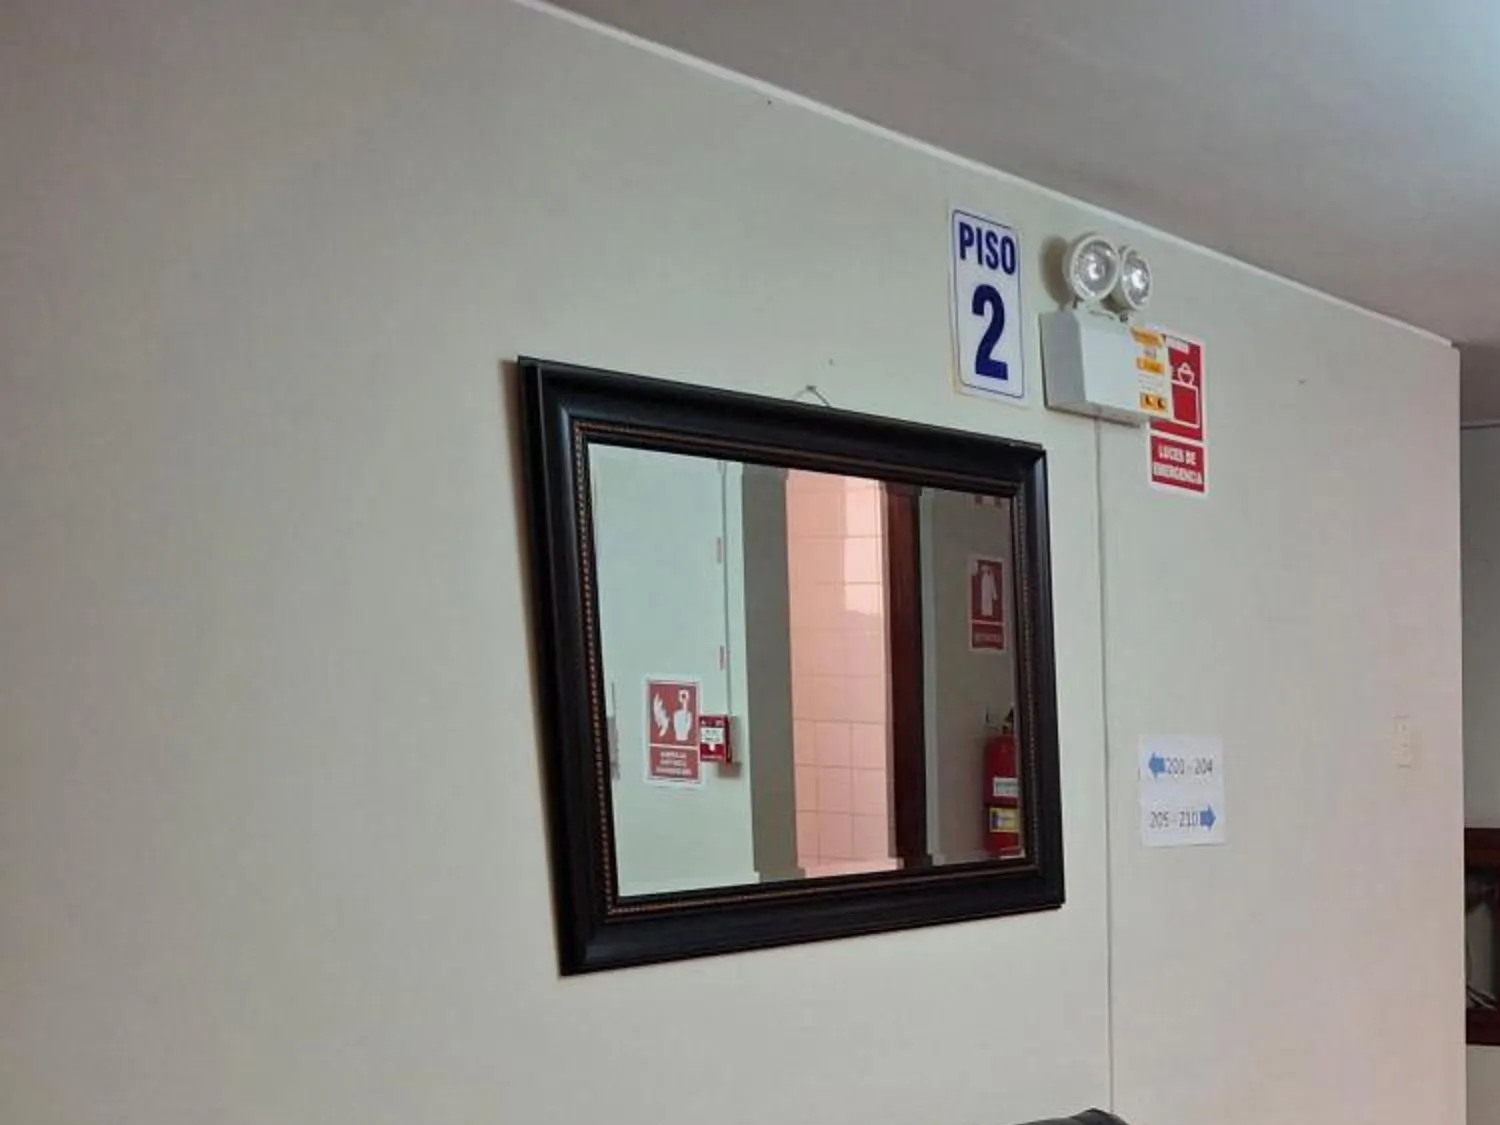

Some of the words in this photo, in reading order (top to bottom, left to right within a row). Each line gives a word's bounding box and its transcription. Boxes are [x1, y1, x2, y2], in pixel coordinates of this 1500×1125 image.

[959, 221, 1016, 275] PISO
[972, 284, 1008, 380] 2
[1185, 449, 1197, 466] DE
